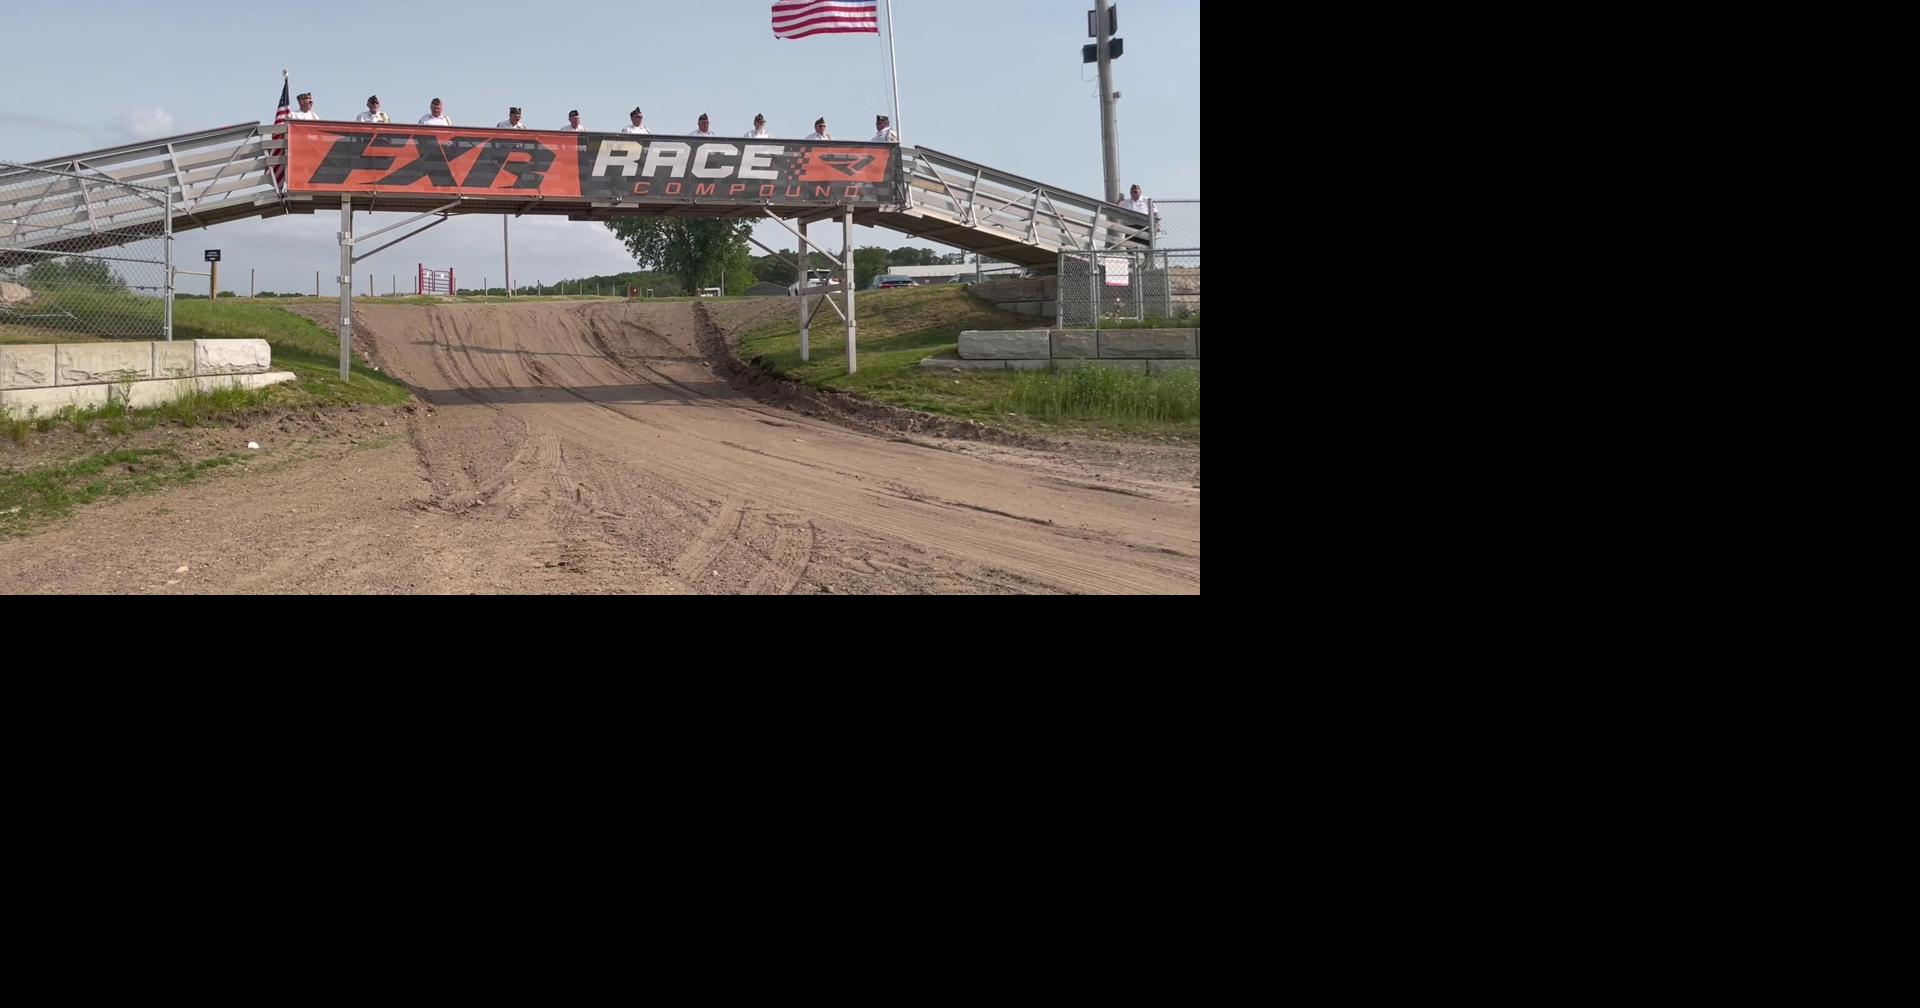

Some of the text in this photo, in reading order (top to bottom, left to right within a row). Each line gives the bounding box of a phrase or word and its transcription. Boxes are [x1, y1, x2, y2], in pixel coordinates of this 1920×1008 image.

[308, 130, 556, 189] FXR
[591, 139, 785, 180] RACE
[632, 181, 862, 198] COMPOUND
